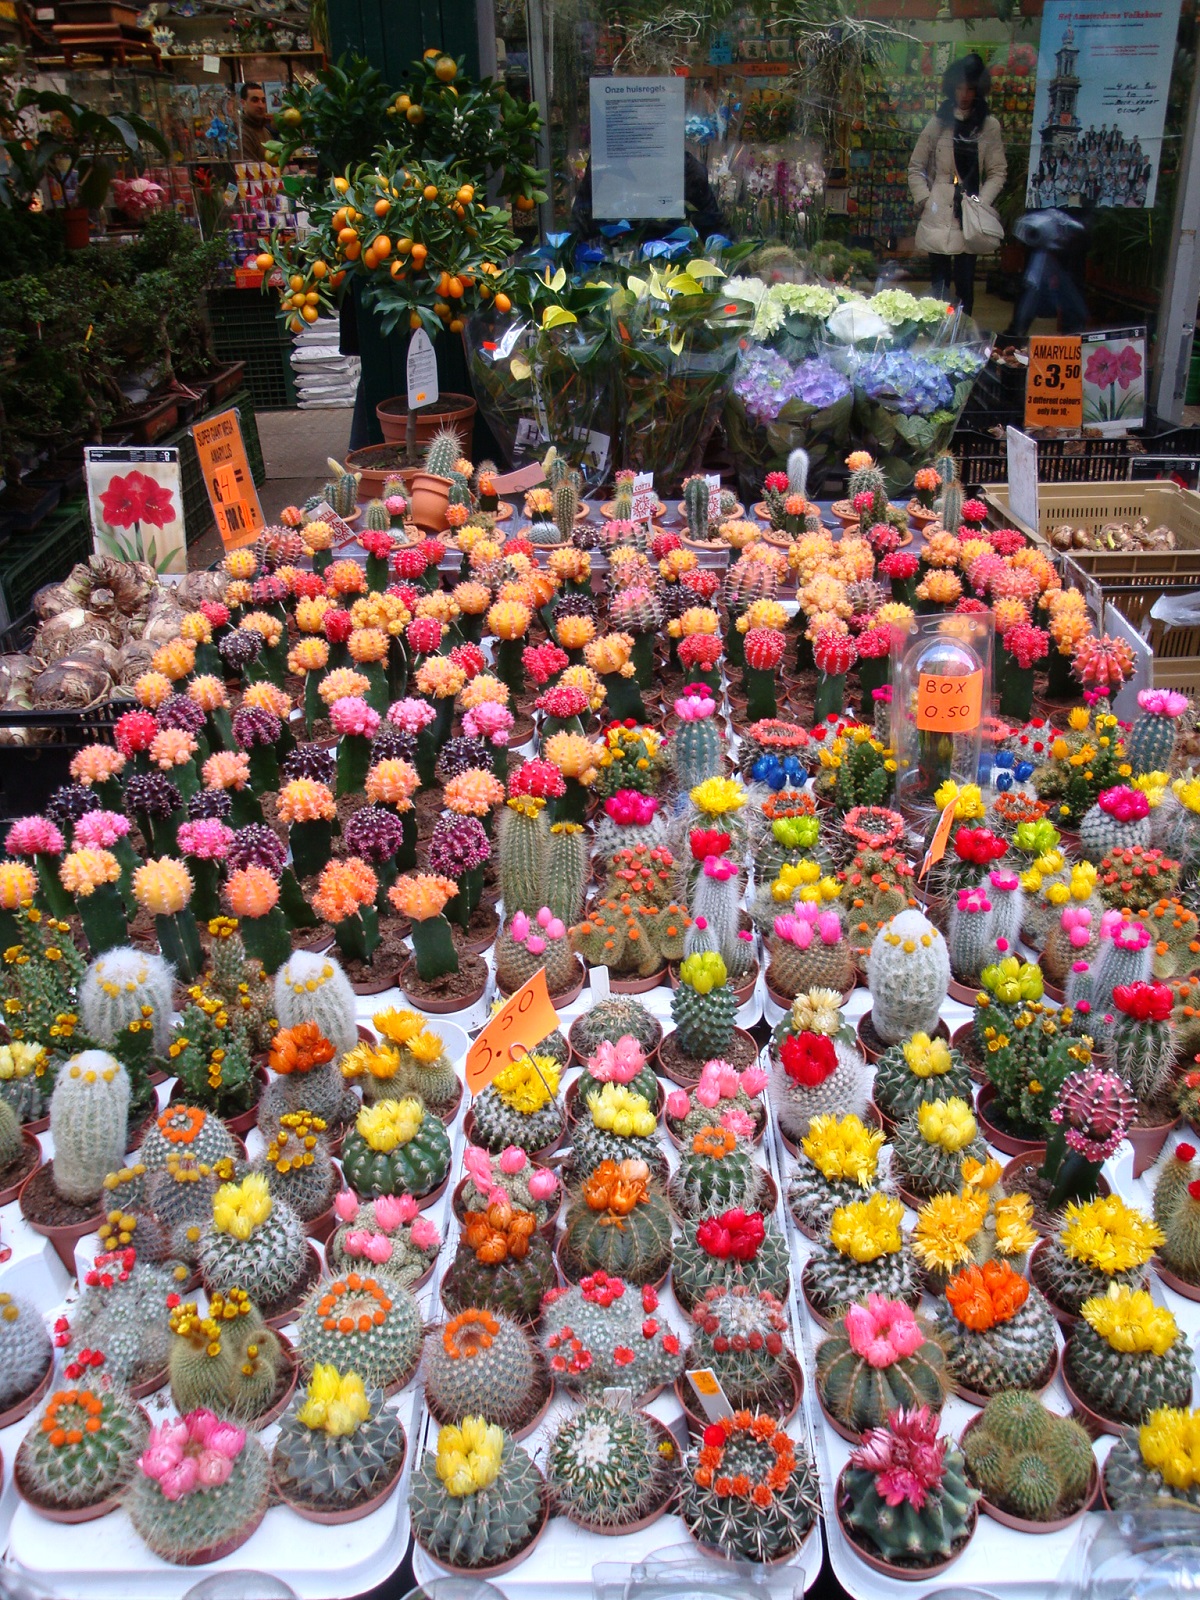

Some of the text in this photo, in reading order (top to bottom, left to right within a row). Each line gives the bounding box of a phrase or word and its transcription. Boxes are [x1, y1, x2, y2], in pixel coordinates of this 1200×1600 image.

[1058, 9, 1163, 20] Het Amsterdams Volkskoor
[605, 84, 666, 94] Onze huisregels
[1033, 345, 1082, 360] AMARYLLIS
[1027, 396, 1081, 406] 3 different colours
[1037, 408, 1050, 416] only
[1050, 408, 1059, 416] for
[196, 419, 234, 447] SUPER GIANT MEGA
[210, 443, 233, 463] AMARYLLIS
[225, 507, 240, 532] FOR
[926, 679, 967, 694] BOX
[924, 705, 970, 718] 0.50
[473, 989, 535, 1076] 3.50
